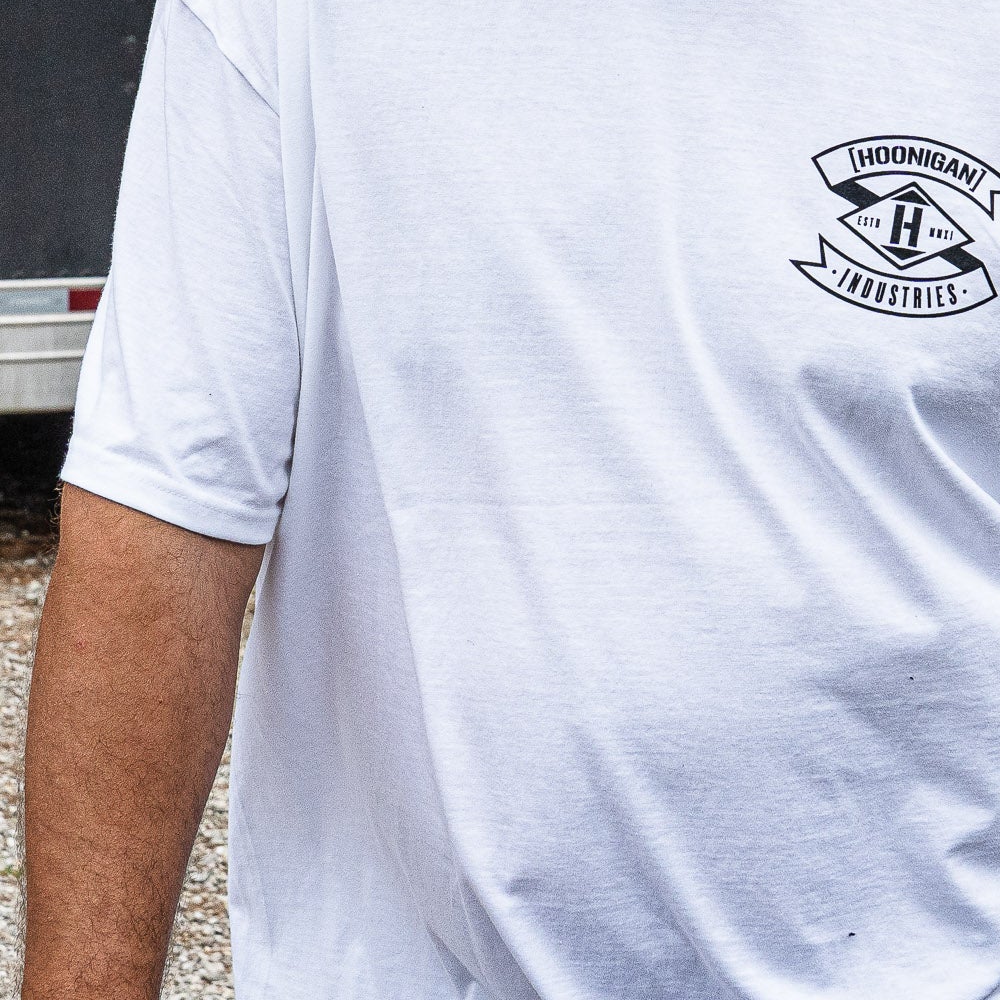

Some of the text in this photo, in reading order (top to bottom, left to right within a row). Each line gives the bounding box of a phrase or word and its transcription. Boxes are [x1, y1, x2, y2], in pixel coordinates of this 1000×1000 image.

[848, 145, 988, 193] [HOONIGAN]
[857, 215, 881, 229] ESTD
[889, 203, 924, 248] H
